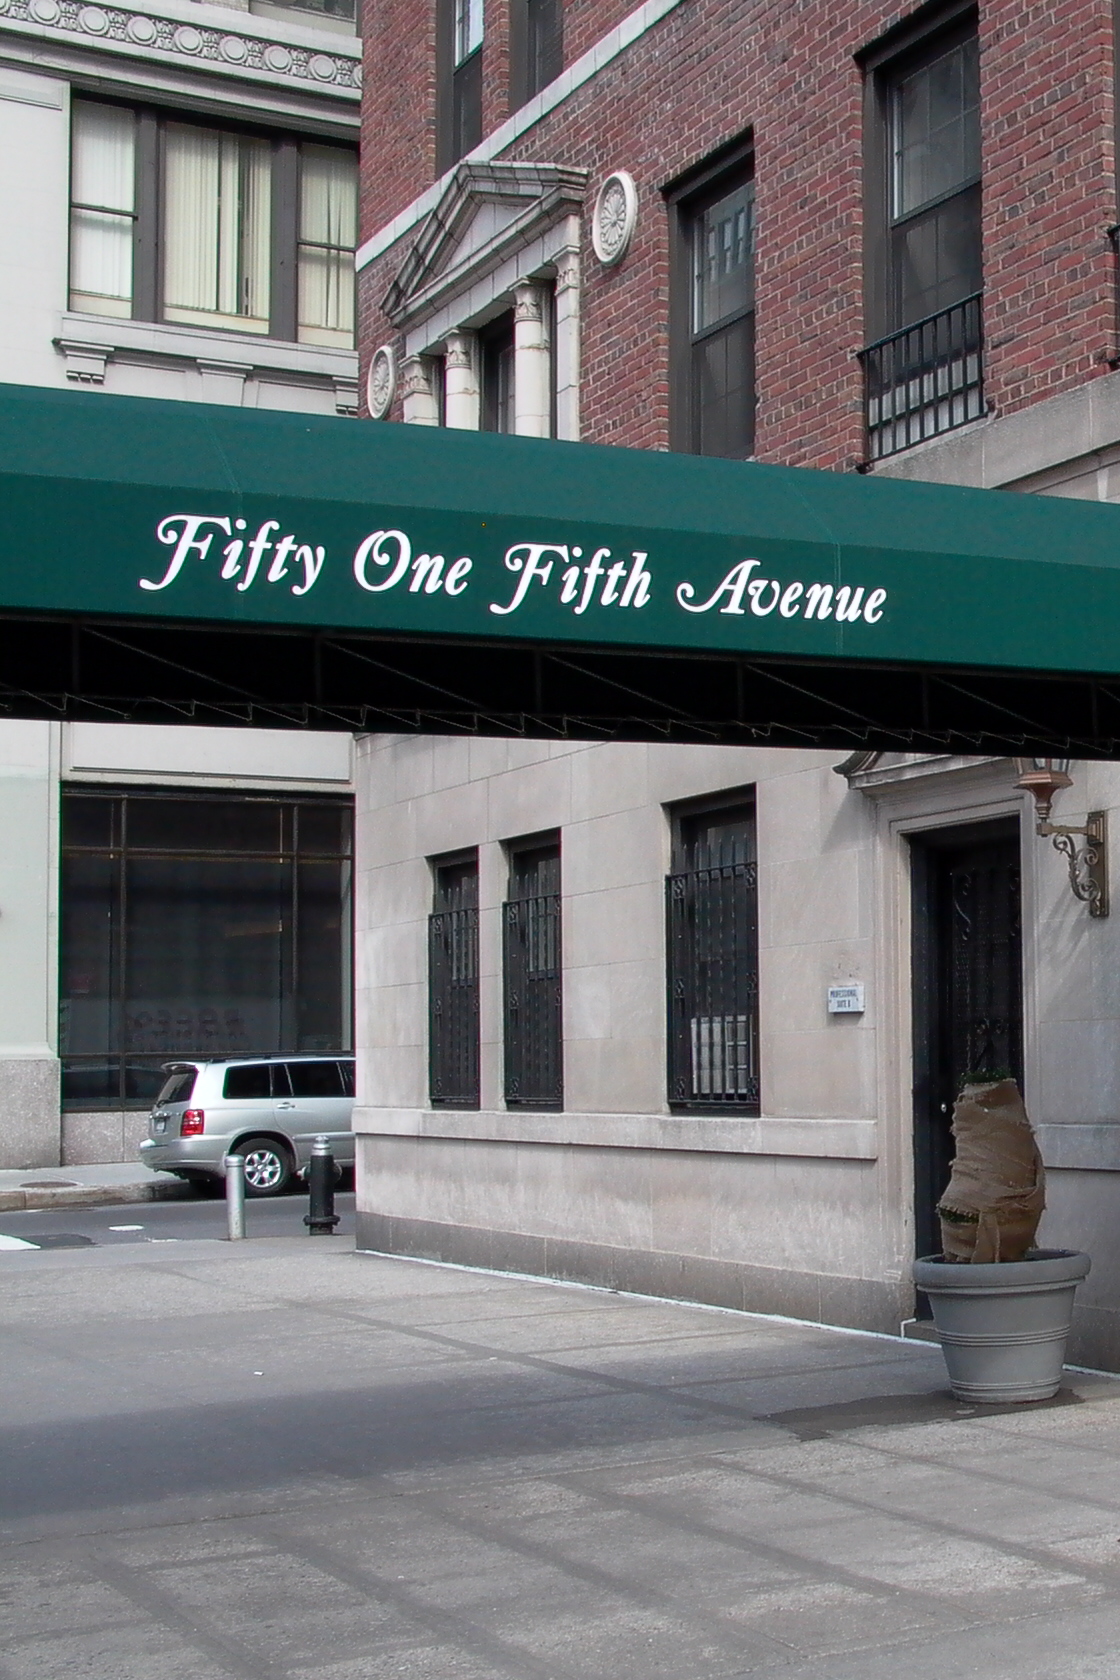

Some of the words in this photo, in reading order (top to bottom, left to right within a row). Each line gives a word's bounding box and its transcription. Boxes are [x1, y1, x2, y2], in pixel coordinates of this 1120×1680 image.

[138, 514, 327, 596] Fifty
[353, 529, 473, 597] One
[489, 543, 653, 615] Fifth
[675, 558, 888, 624] Avenue
